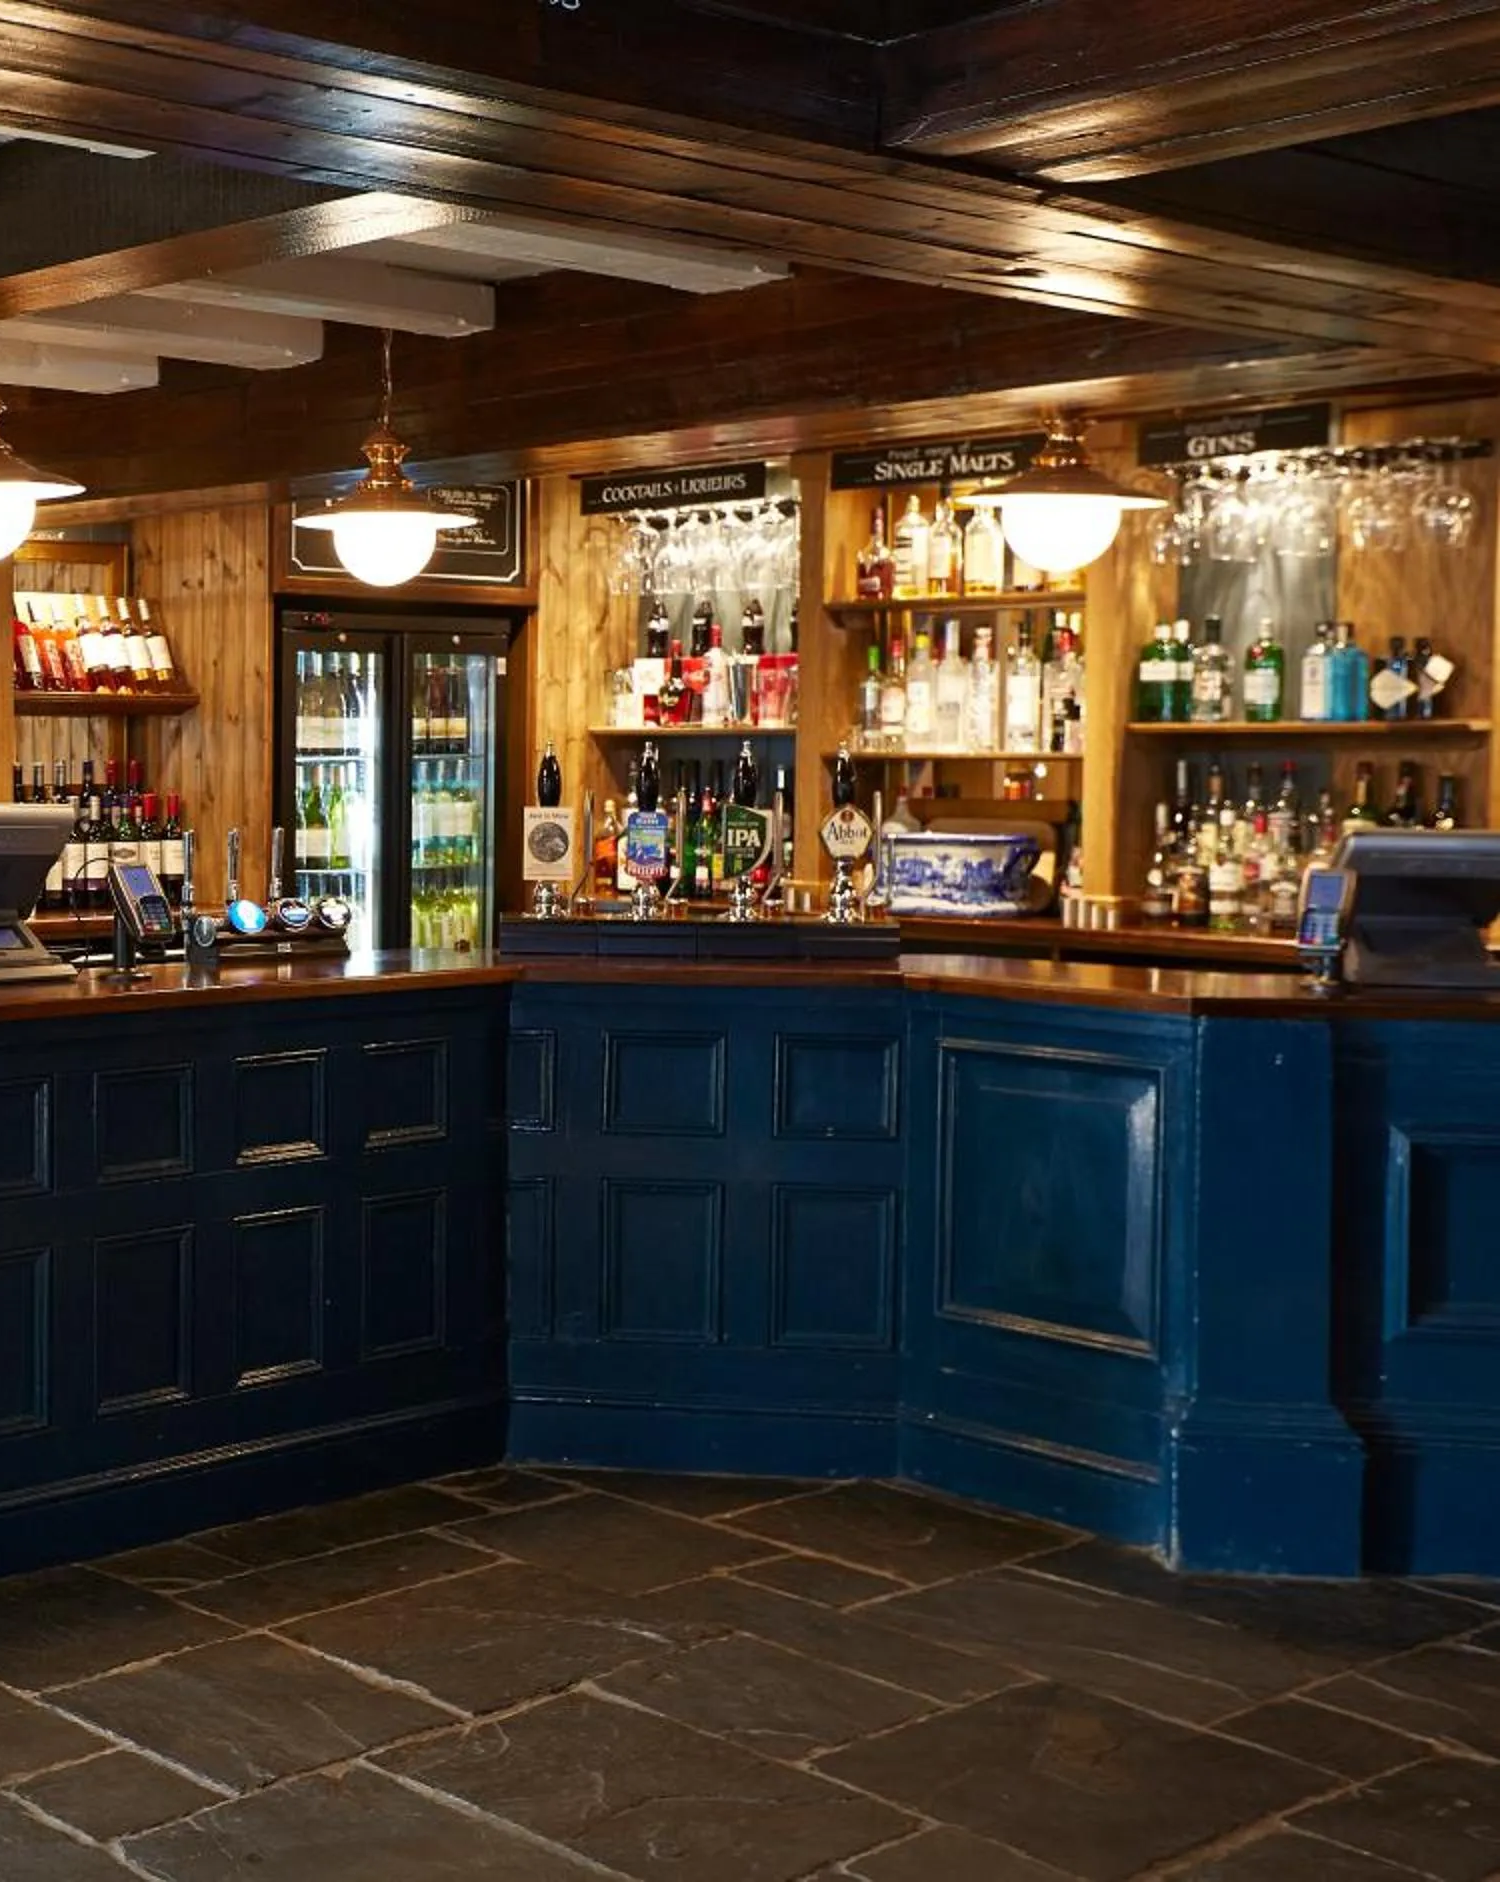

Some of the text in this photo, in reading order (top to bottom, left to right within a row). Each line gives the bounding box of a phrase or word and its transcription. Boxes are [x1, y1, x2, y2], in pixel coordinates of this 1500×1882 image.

[1187, 431, 1256, 457] GINS
[874, 451, 1015, 481] SINGLE MALTS
[602, 482, 672, 503] COCKTAILS
[681, 473, 747, 495] LIQUEURS
[727, 829, 761, 847] IPA
